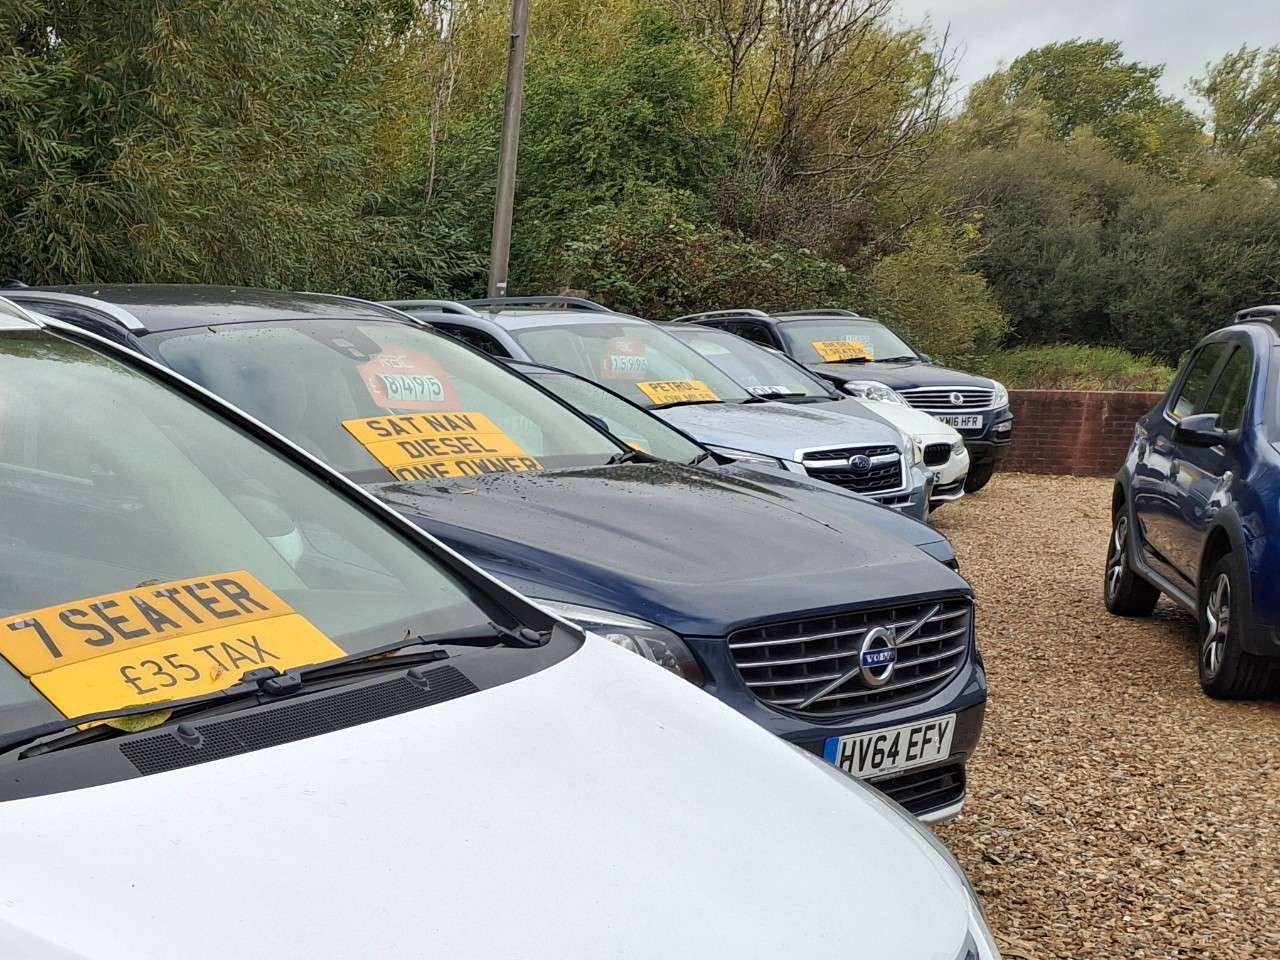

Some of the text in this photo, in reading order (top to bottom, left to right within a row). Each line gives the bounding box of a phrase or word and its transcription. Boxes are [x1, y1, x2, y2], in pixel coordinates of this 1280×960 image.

[384, 375, 442, 396] 8495
[647, 380, 700, 393] PETROL
[366, 413, 478, 438] SAT NAV
[961, 415, 978, 427] HFR
[396, 435, 499, 460] DIESEL
[395, 462, 450, 481] ONE
[6, 577, 270, 659] 7 SEATER
[119, 634, 281, 696] £35 TAX
[839, 719, 950, 774] HV64 EFY
